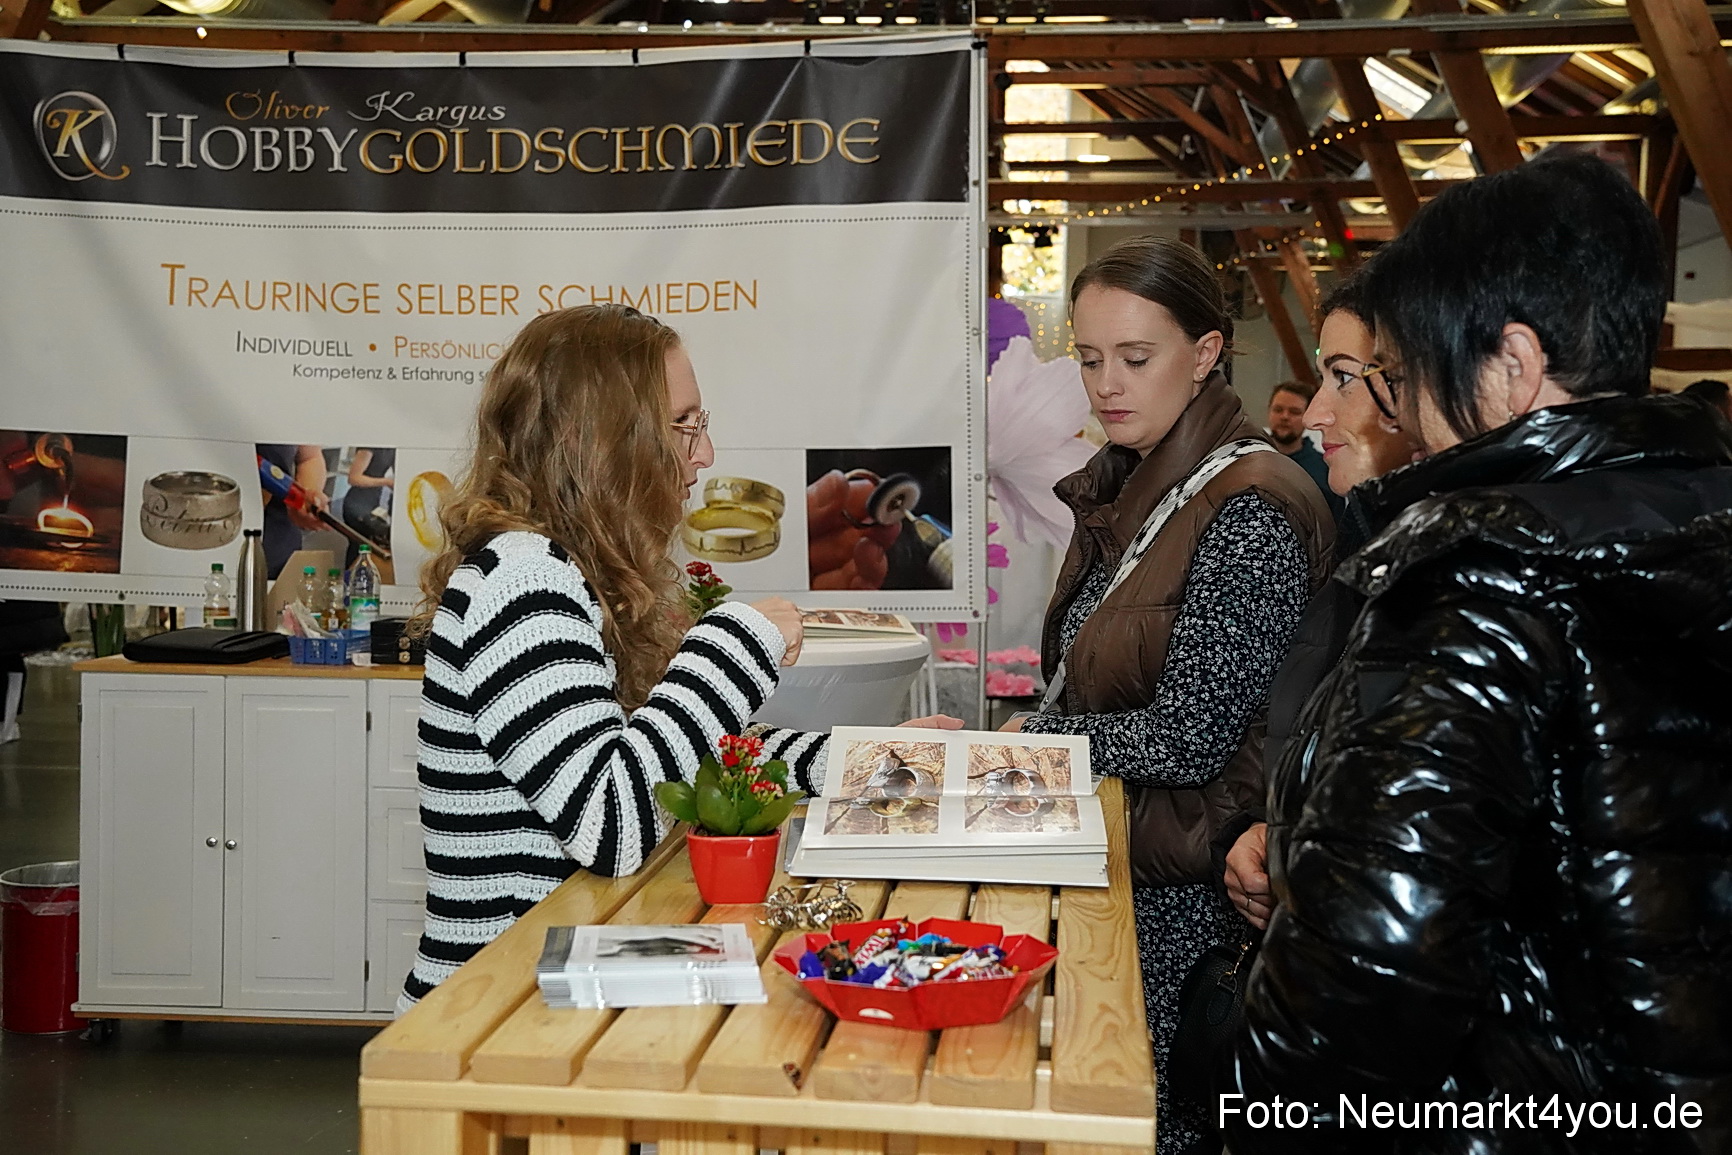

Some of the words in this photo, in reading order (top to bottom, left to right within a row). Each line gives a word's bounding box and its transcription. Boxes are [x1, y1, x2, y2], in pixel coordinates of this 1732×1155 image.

[225, 90, 329, 120] Oliver
[347, 90, 506, 128] Kargus
[145, 112, 881, 174] HOBBYGOLDSCHMIEDE
[161, 263, 381, 315] TRAURINGE
[396, 283, 520, 315] SELBER
[537, 279, 758, 315] SCHMIEDEN
[236, 330, 353, 358] INDIVIDUELL
[394, 335, 505, 360] PERSÖNLIC
[293, 363, 383, 382] Kompetenz
[387, 366, 397, 380] &
[402, 366, 474, 385] Erfahrung
